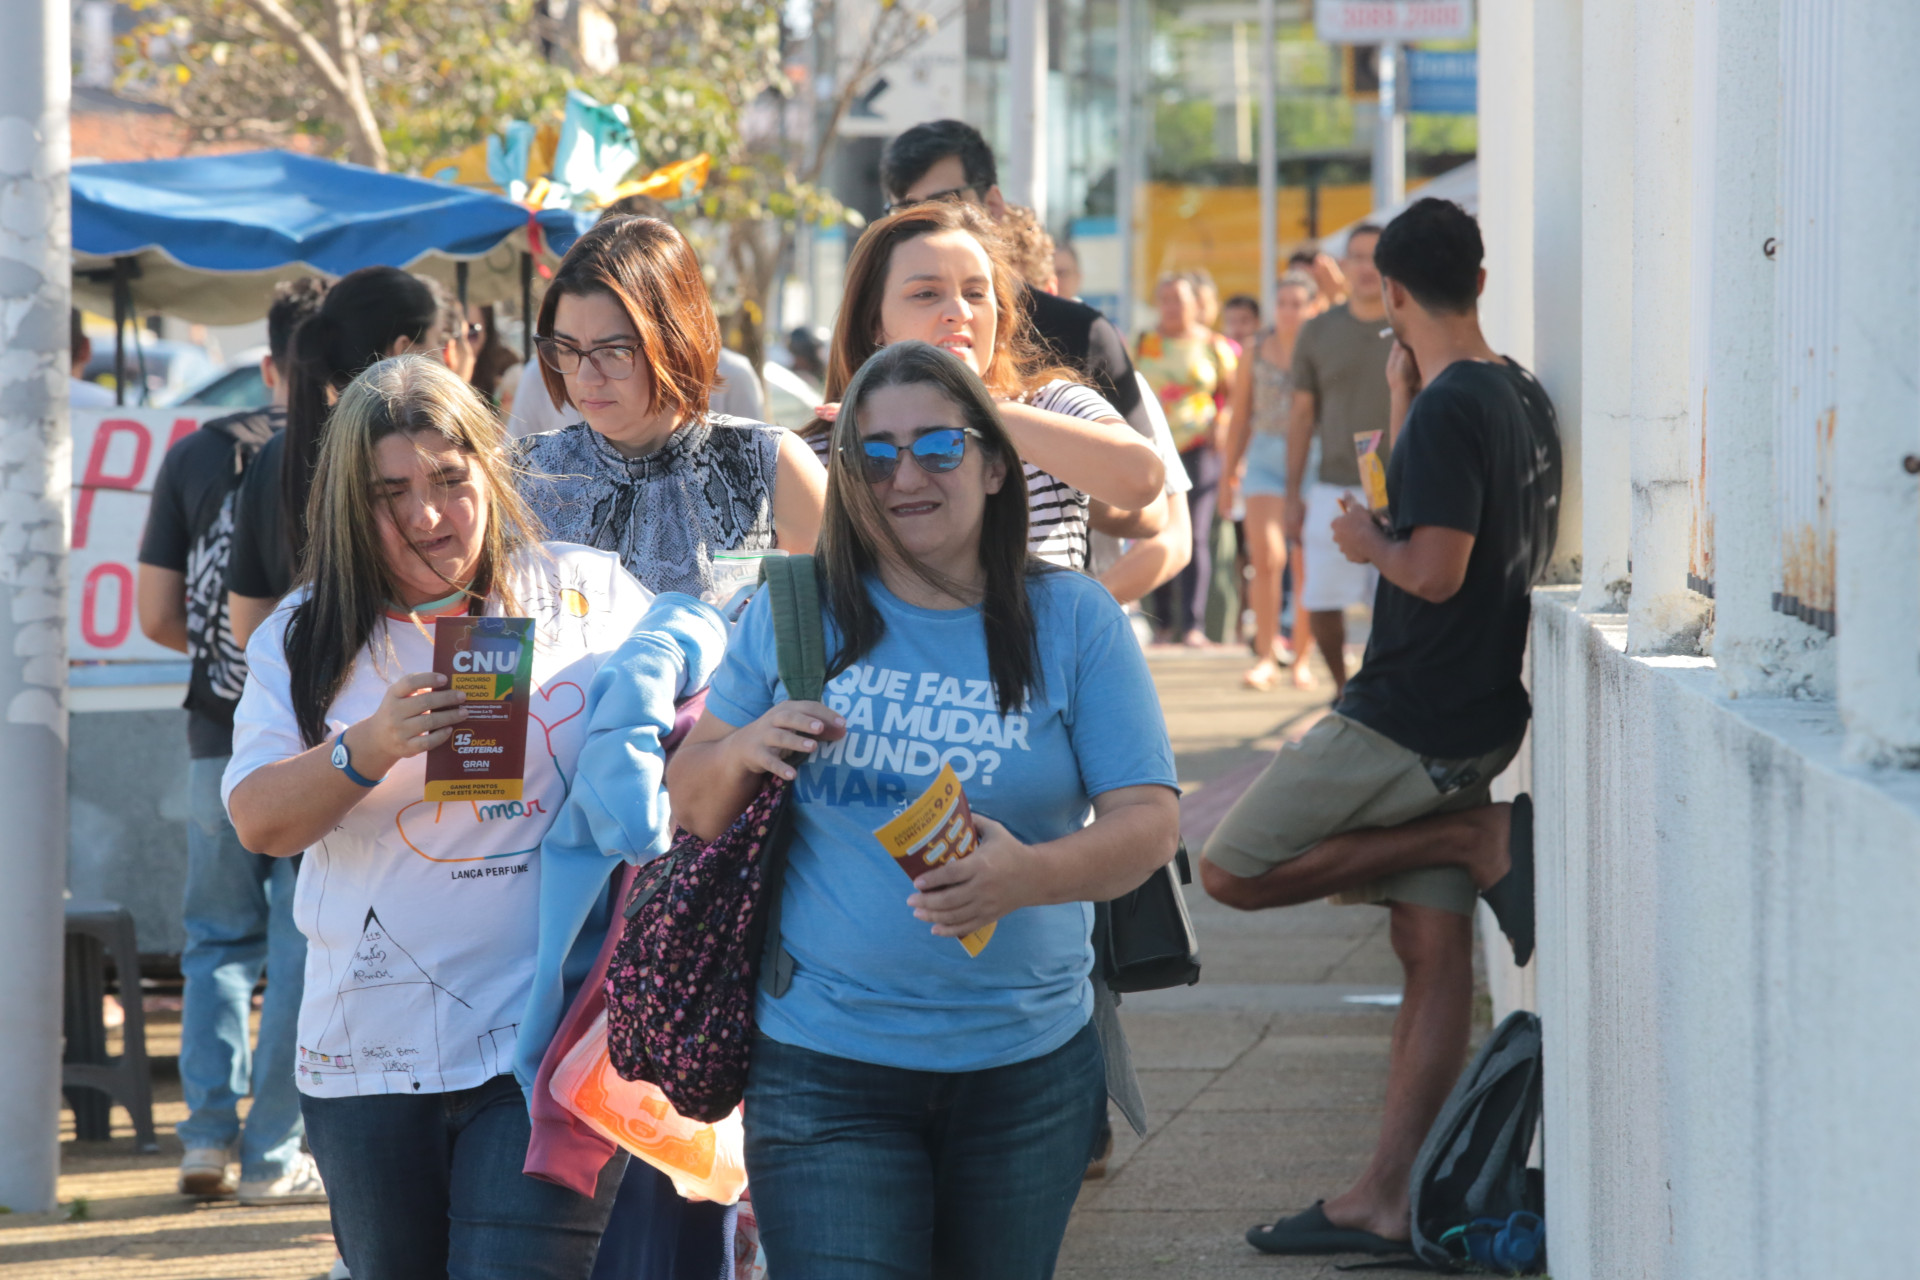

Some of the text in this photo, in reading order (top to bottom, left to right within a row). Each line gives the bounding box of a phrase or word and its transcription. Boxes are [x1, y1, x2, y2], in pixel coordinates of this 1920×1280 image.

[452, 650, 516, 673] CNU
[827, 663, 912, 700] QUE
[881, 701, 1032, 751] MUDAR
[454, 733, 497, 747] 15 DICAS
[457, 746, 504, 754] CERTEIRAS
[462, 760, 490, 769] GRAN
[807, 731, 1002, 786] MUNDO?
[794, 764, 907, 808] MAR
[451, 863, 529, 880] LANÇA PERFUME
